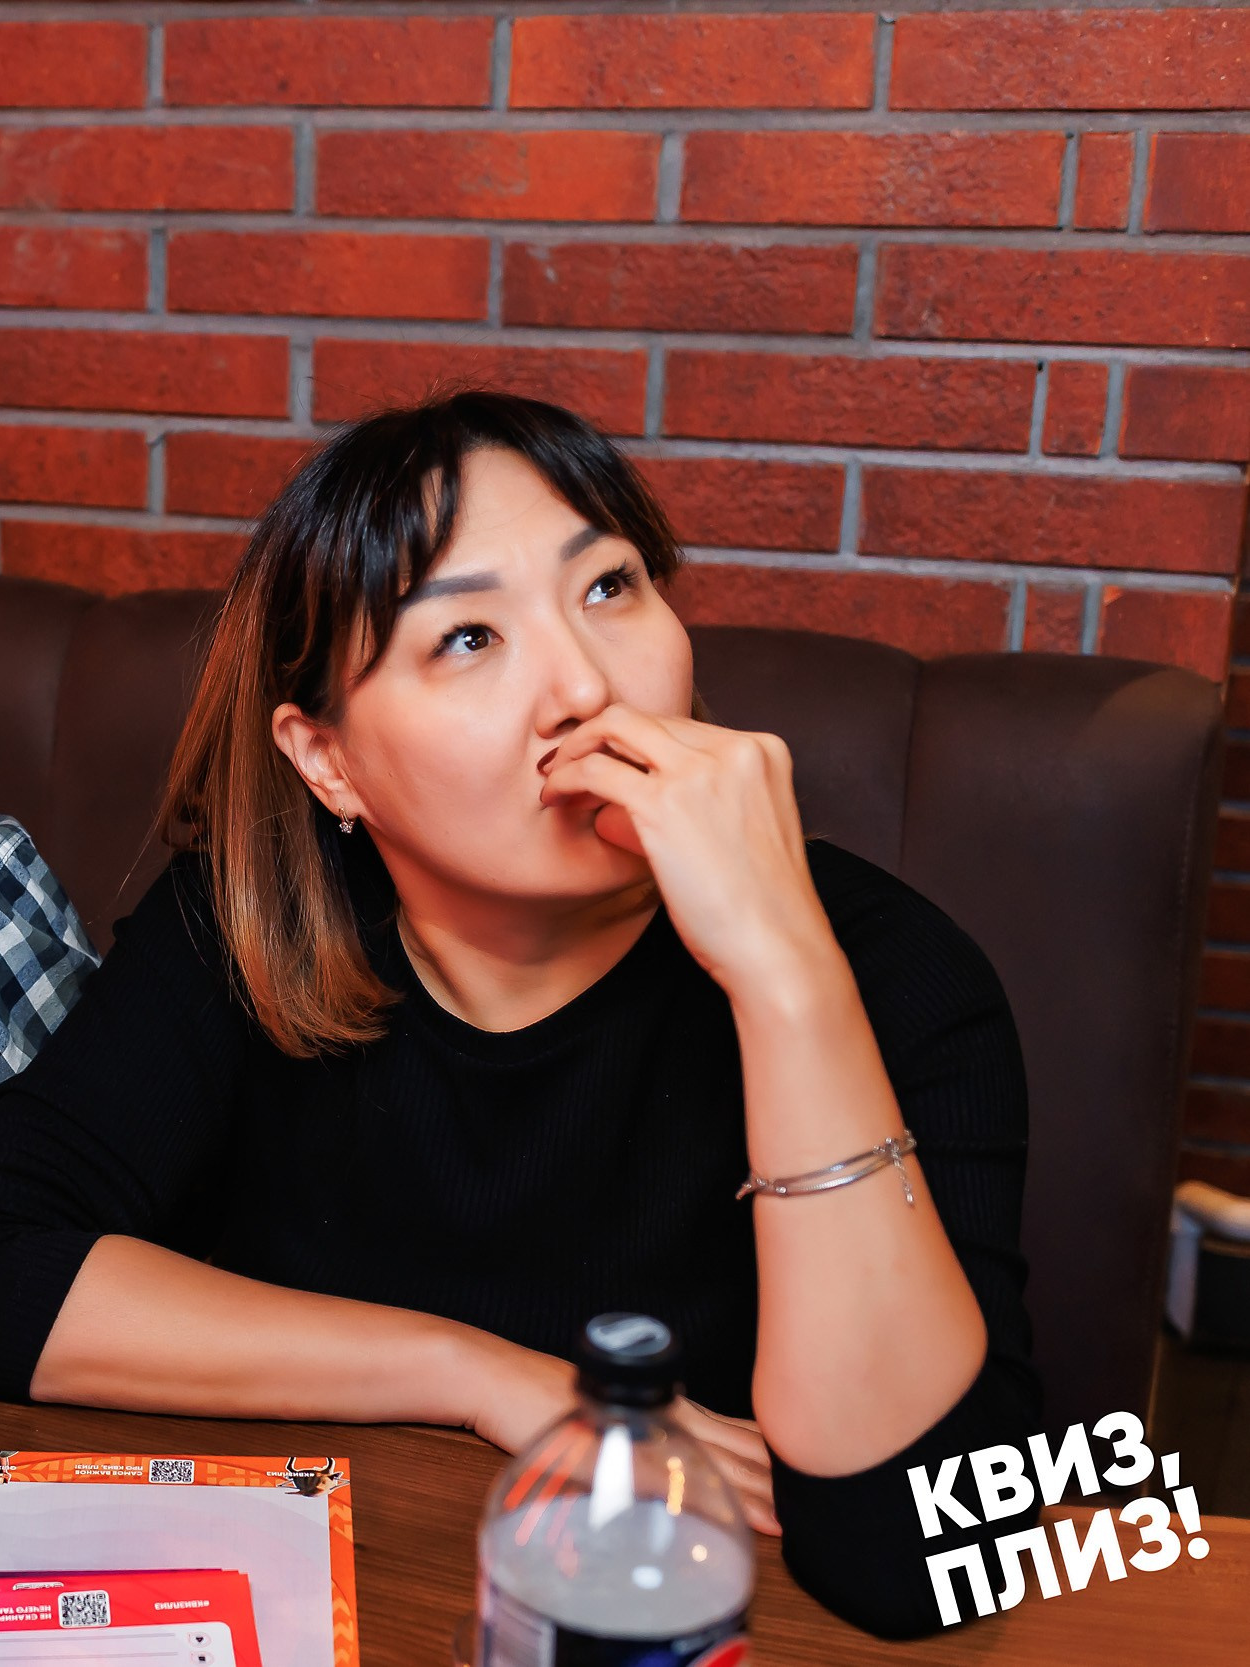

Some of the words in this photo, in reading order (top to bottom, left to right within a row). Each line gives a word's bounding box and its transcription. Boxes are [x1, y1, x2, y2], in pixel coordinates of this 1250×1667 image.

[15, 1605, 52, 1614] НЕЧЕГО
[155, 1600, 210, 1611] #КВИЗПЛИЗ
[39, 1613, 52, 1621] НЕ
